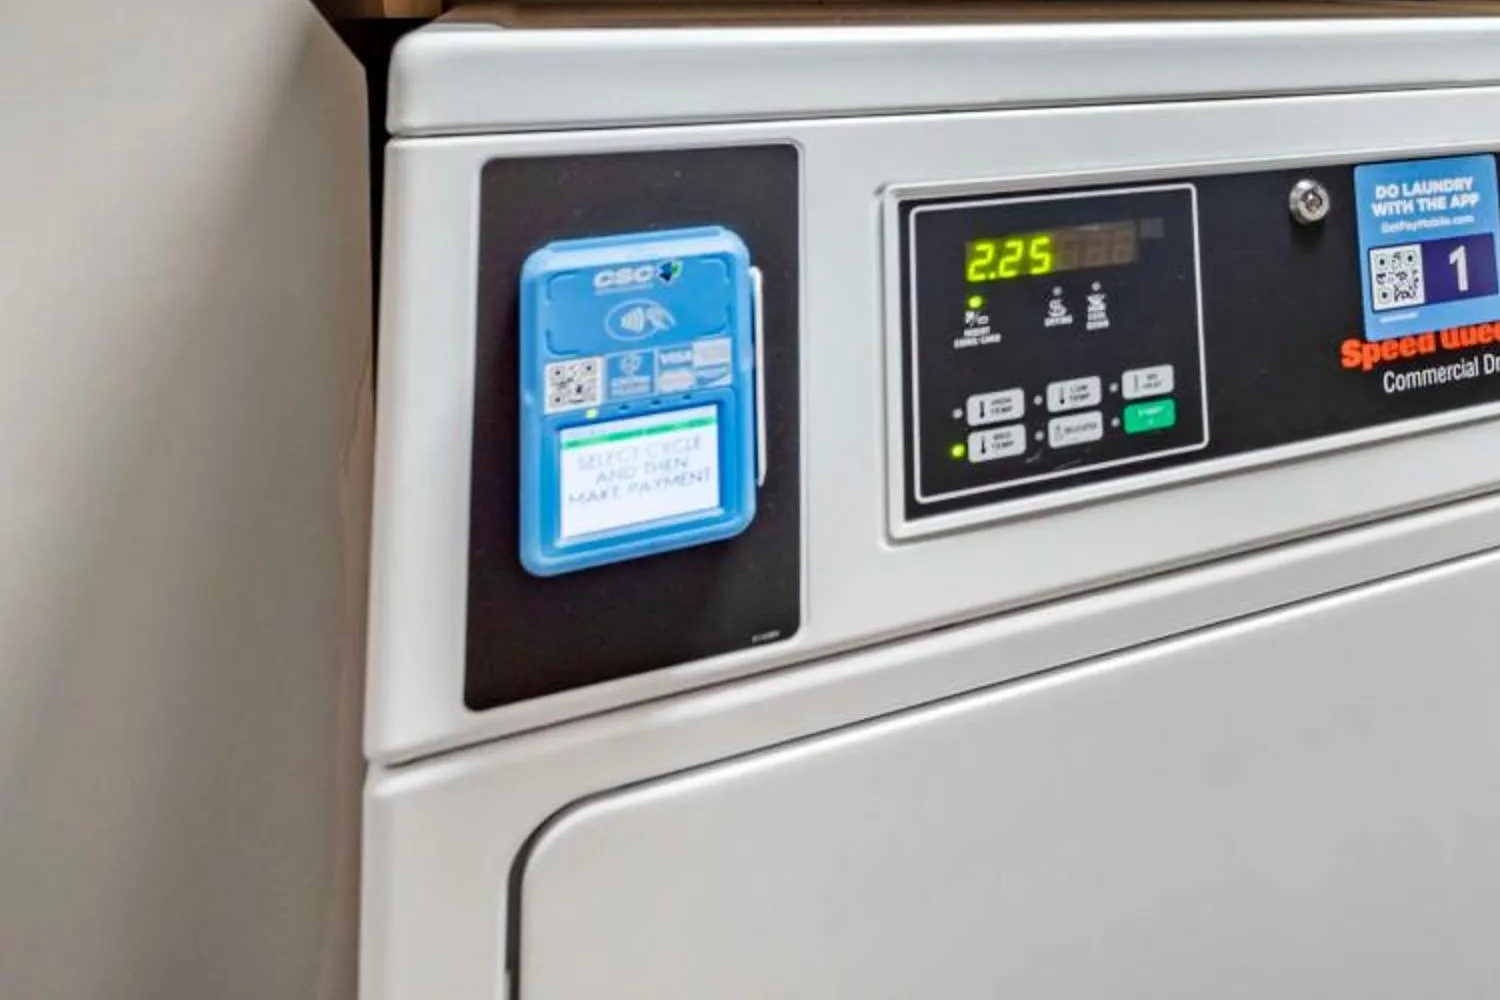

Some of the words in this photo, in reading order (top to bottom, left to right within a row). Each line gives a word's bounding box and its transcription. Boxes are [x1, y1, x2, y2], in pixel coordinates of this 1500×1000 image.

[1375, 184, 1399, 200] DO
[1403, 176, 1473, 197] LAUNDRY
[1372, 201, 1414, 217] WITH
[1418, 196, 1446, 212] THE
[1450, 193, 1480, 209] APP
[967, 236, 1051, 282] 2.25
[1449, 245, 1469, 292] 1
[593, 265, 655, 288] CSC
[1383, 356, 1478, 393] Commercial
[577, 445, 640, 470] SELECT
[596, 464, 636, 484] AND
[568, 484, 620, 504] MAKE
[629, 470, 710, 495] PAYMENT
